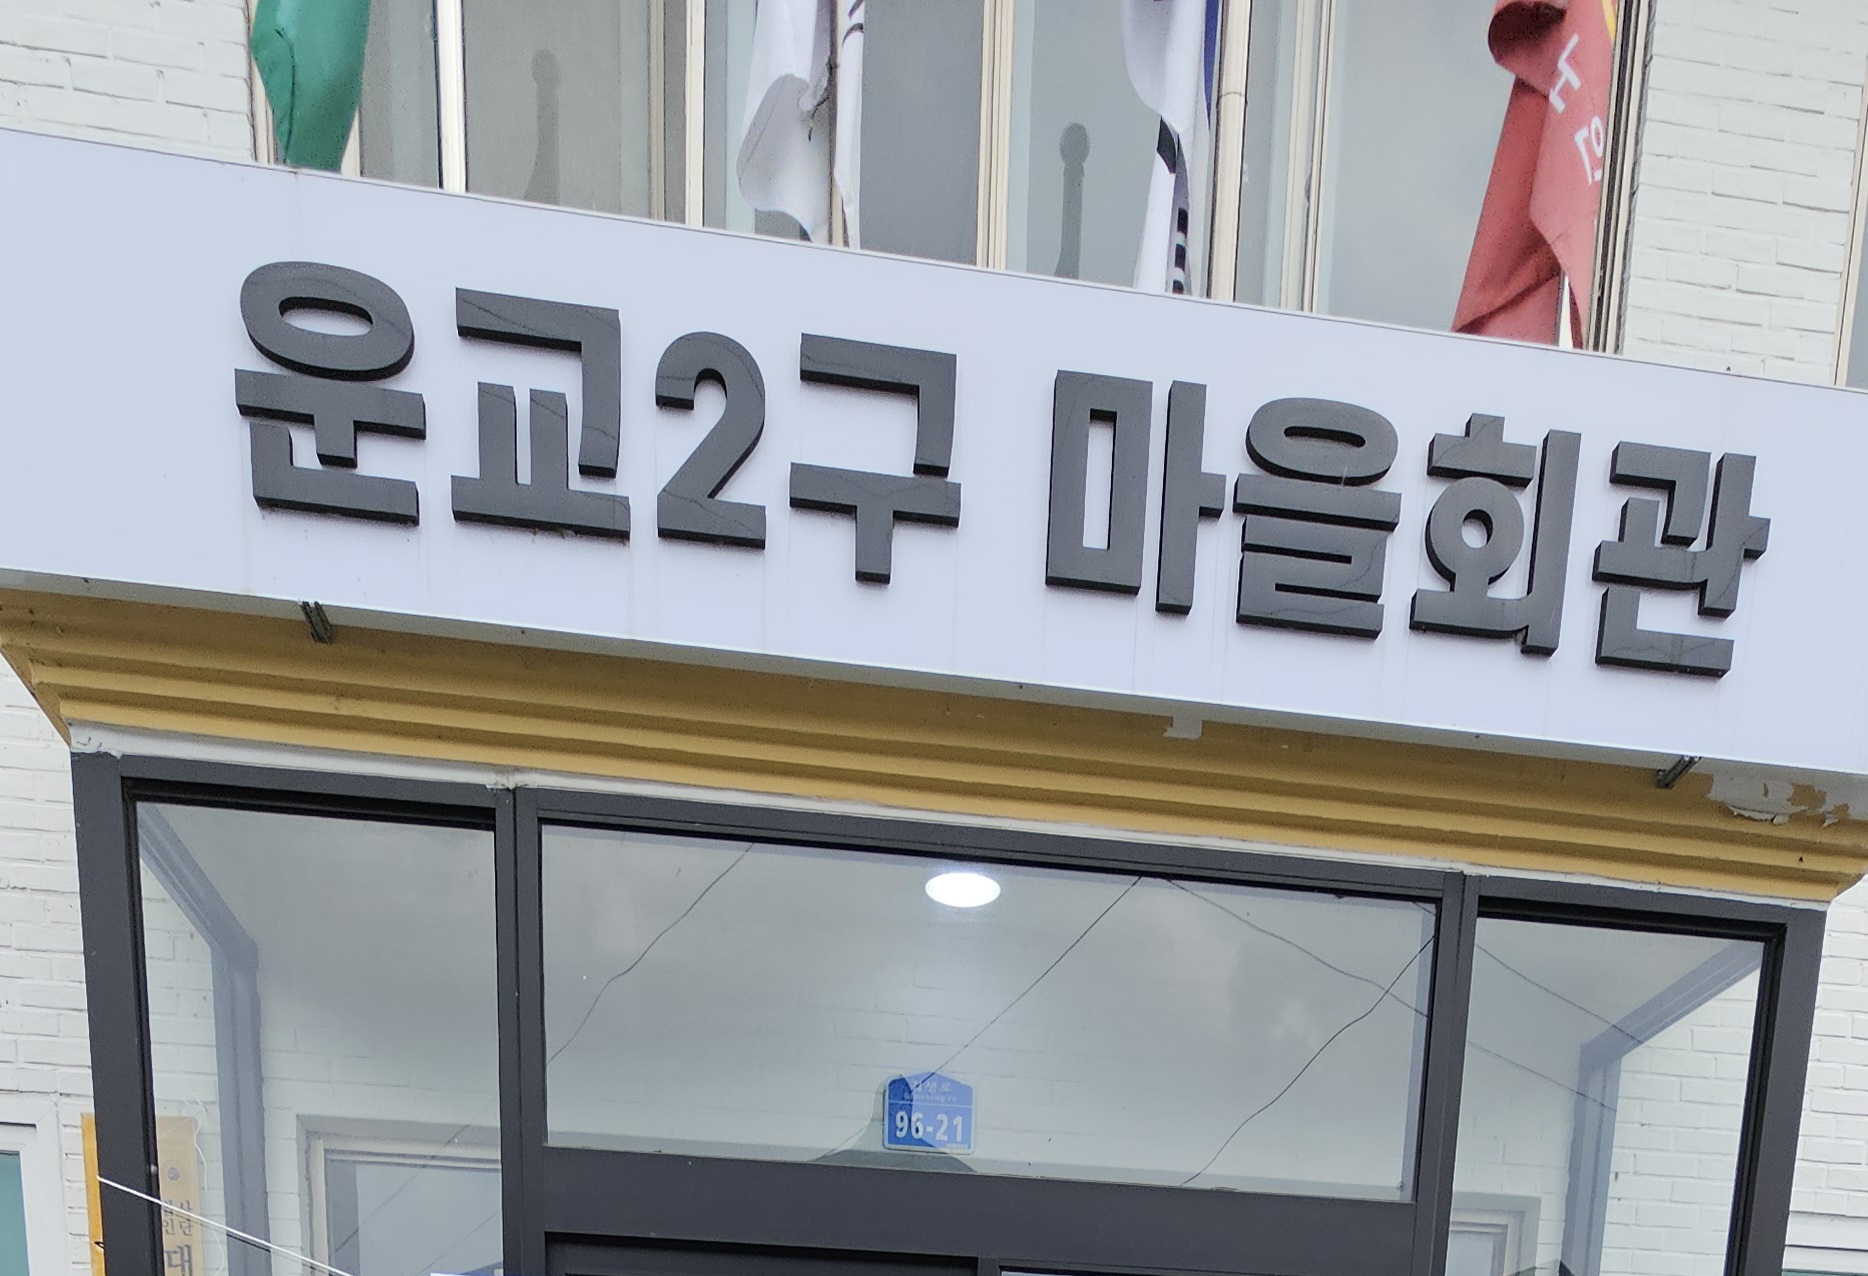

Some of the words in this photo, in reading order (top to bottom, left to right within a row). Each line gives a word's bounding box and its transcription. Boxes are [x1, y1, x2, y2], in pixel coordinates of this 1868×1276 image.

[234, 260, 962, 585] 운교2구
[1045, 370, 1771, 677] 마을회관
[895, 1110, 963, 1142] 96-21
